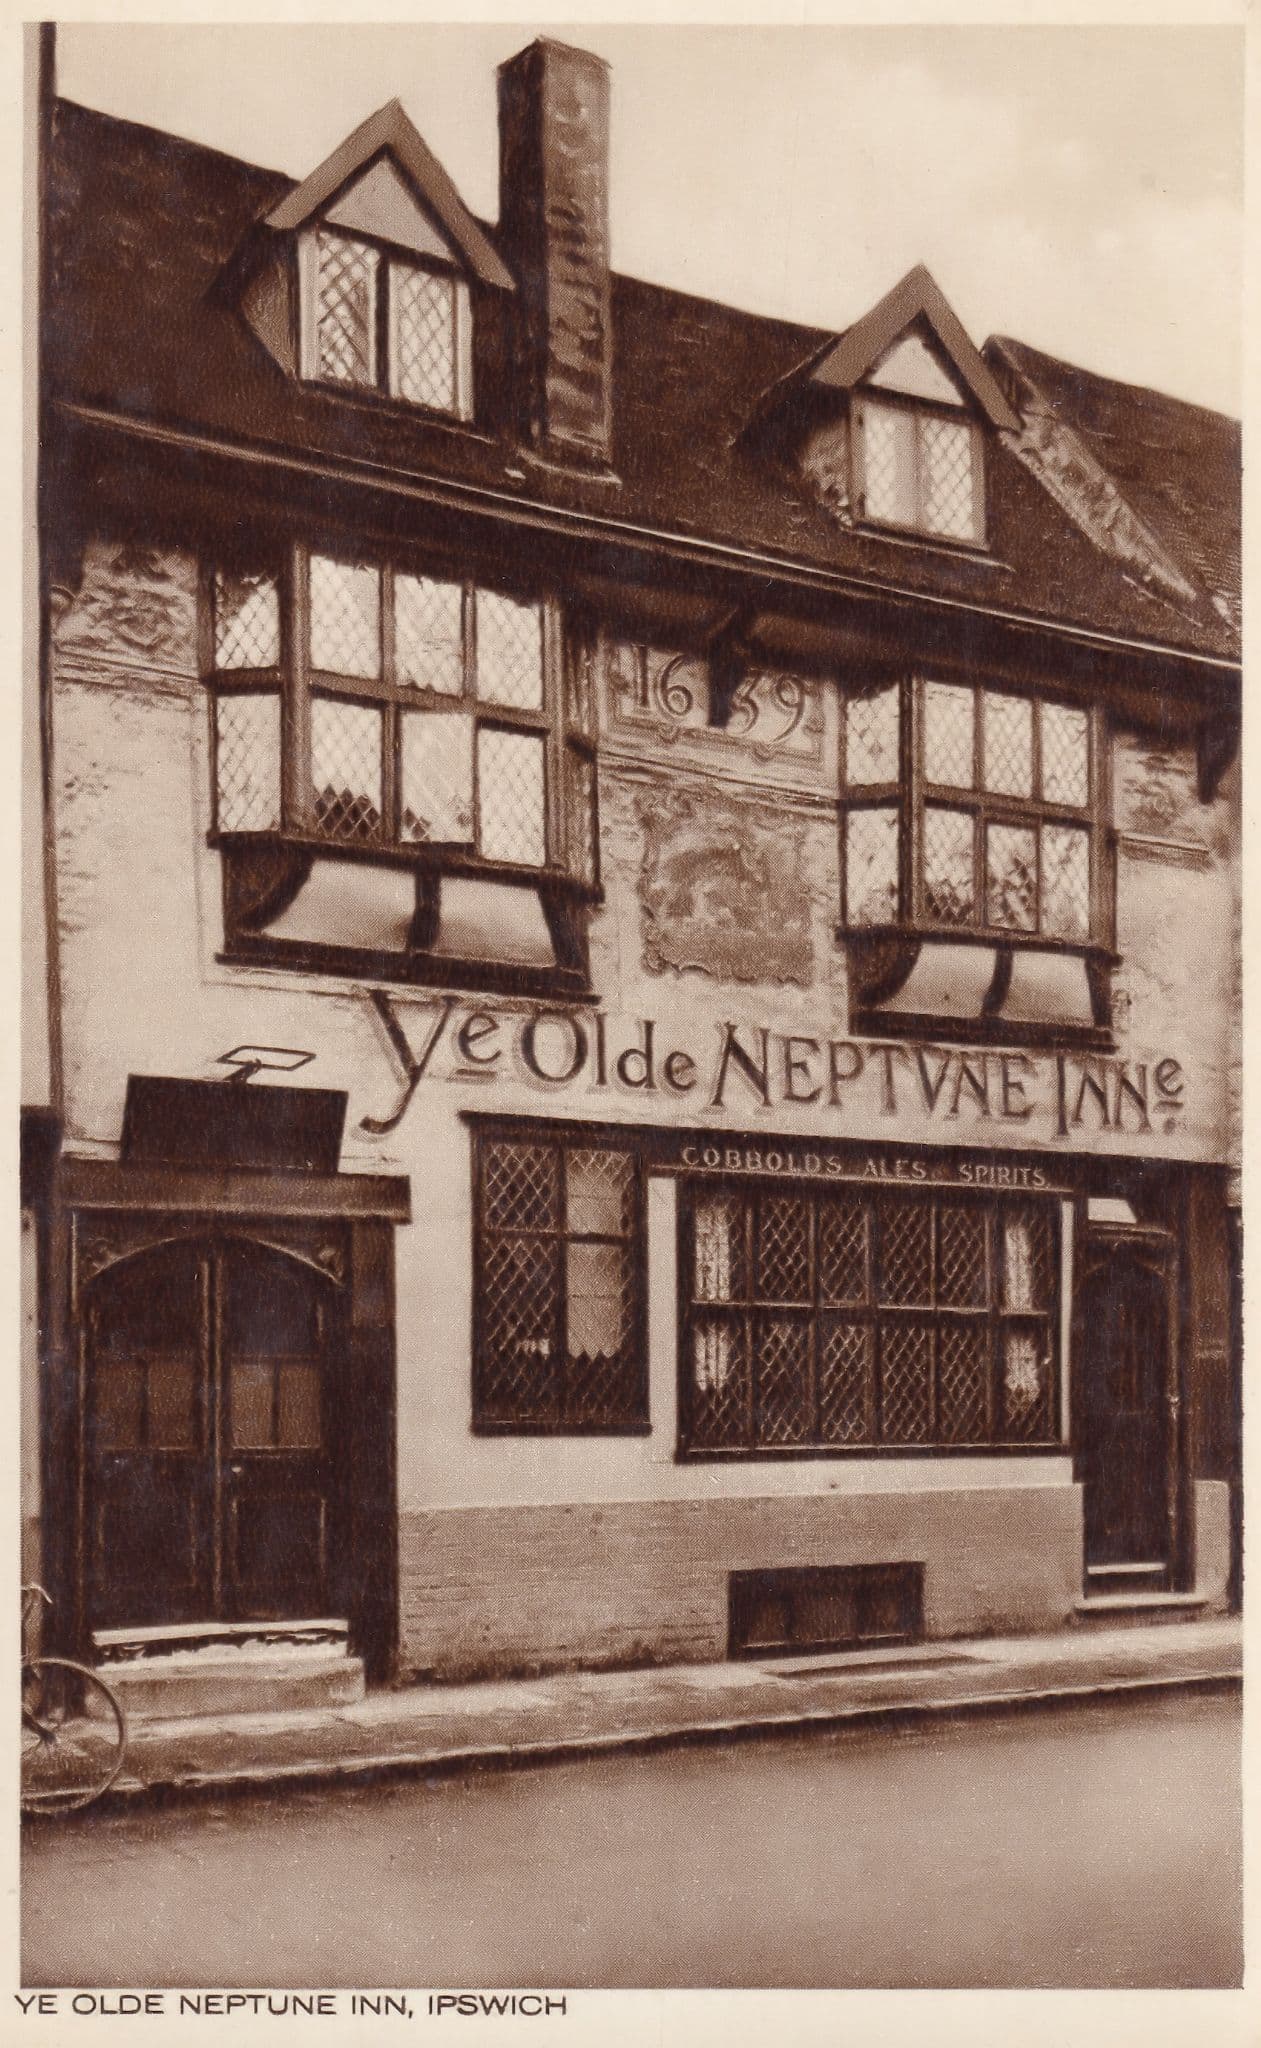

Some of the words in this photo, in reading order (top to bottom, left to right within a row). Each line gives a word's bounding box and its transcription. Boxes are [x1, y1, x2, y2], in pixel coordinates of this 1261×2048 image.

[520, 1006, 698, 1093] Olde
[680, 1145, 842, 1175] COBBOLDS
[863, 1157, 927, 1180] ALES
